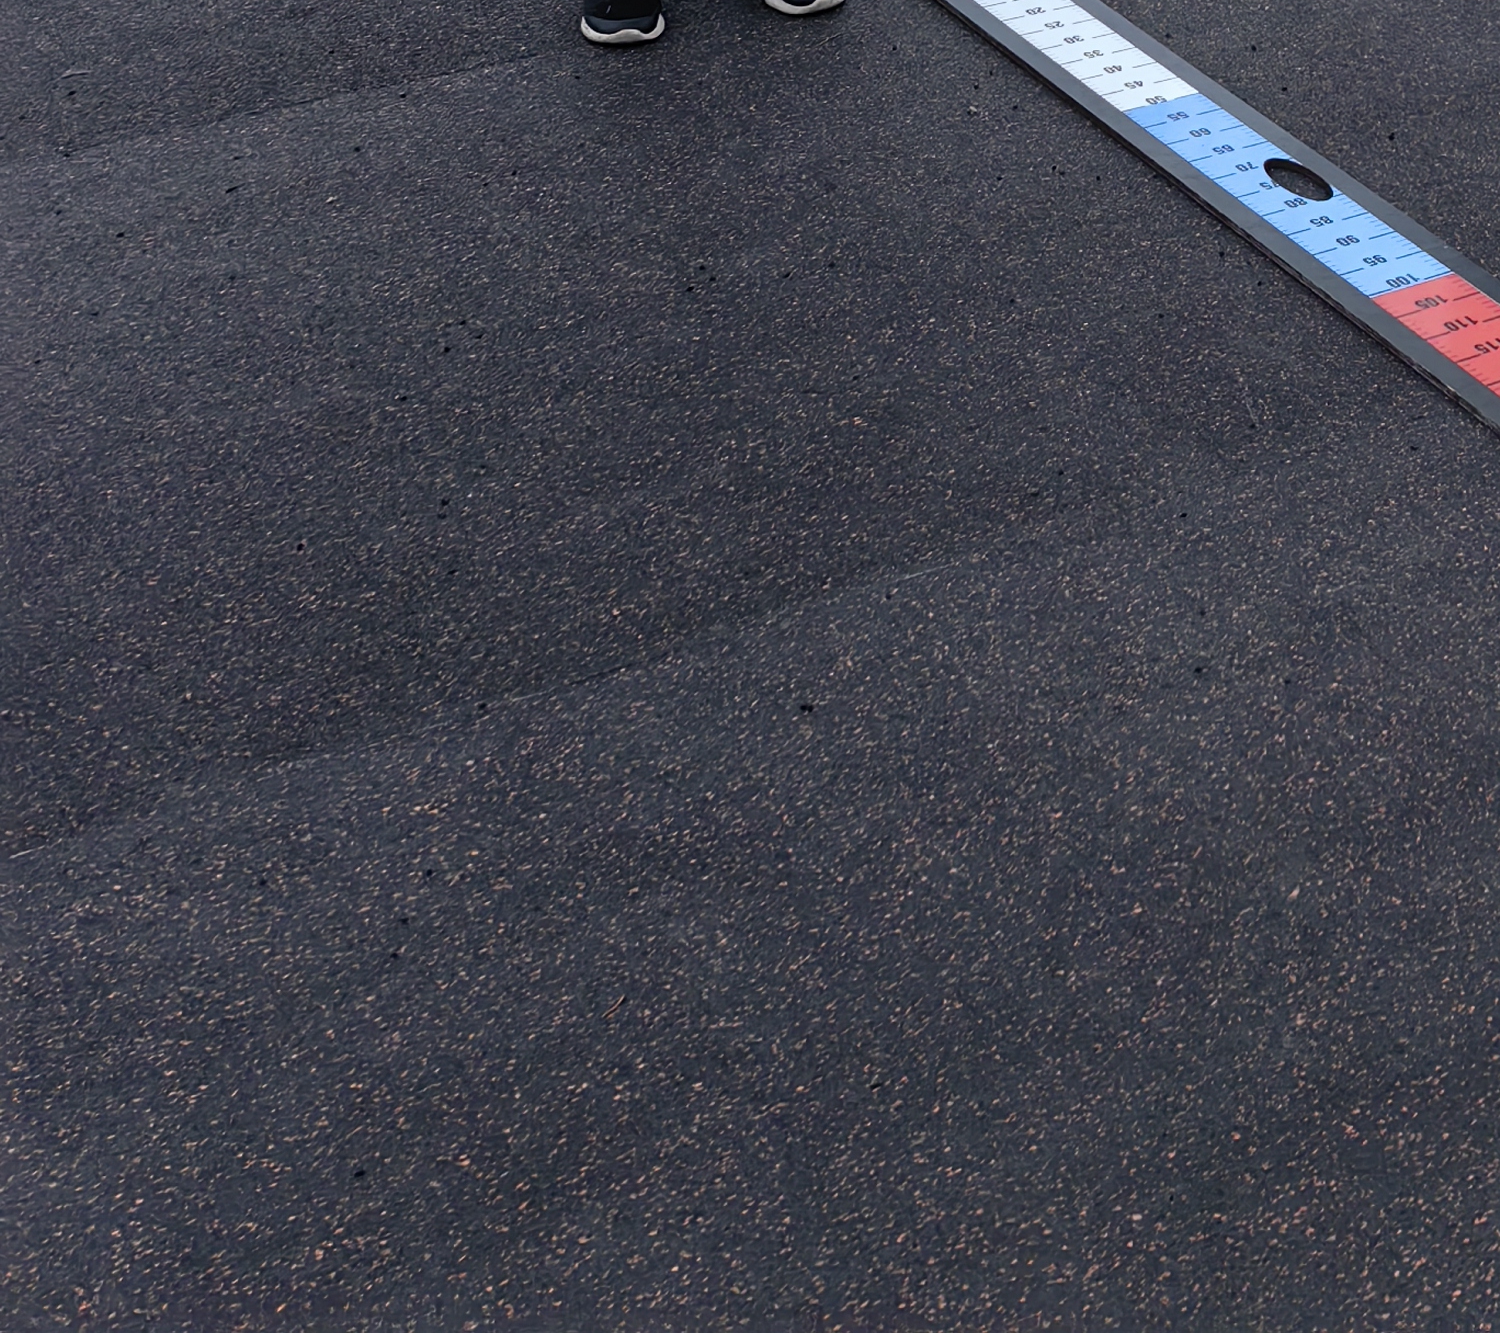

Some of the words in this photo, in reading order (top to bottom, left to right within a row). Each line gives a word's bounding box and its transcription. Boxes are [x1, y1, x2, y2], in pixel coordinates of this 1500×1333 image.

[1025, 7, 1046, 16] 20
[1044, 20, 1065, 30] 25
[1063, 35, 1084, 44] 30
[1083, 49, 1104, 59] 35
[1103, 65, 1123, 74] 40
[1123, 80, 1143, 89] 45
[1145, 95, 1167, 105] 50
[1166, 111, 1190, 121] 55
[1189, 127, 1211, 138] 60
[1212, 144, 1234, 155] 65
[1235, 161, 1259, 172] 70
[1284, 197, 1308, 208] 80
[1309, 215, 1334, 227] 85
[1336, 235, 1360, 246] 90
[1362, 255, 1388, 266] 95
[1386, 273, 1421, 288] 100
[1415, 294, 1449, 310] 105
[1443, 315, 1479, 332] 110
